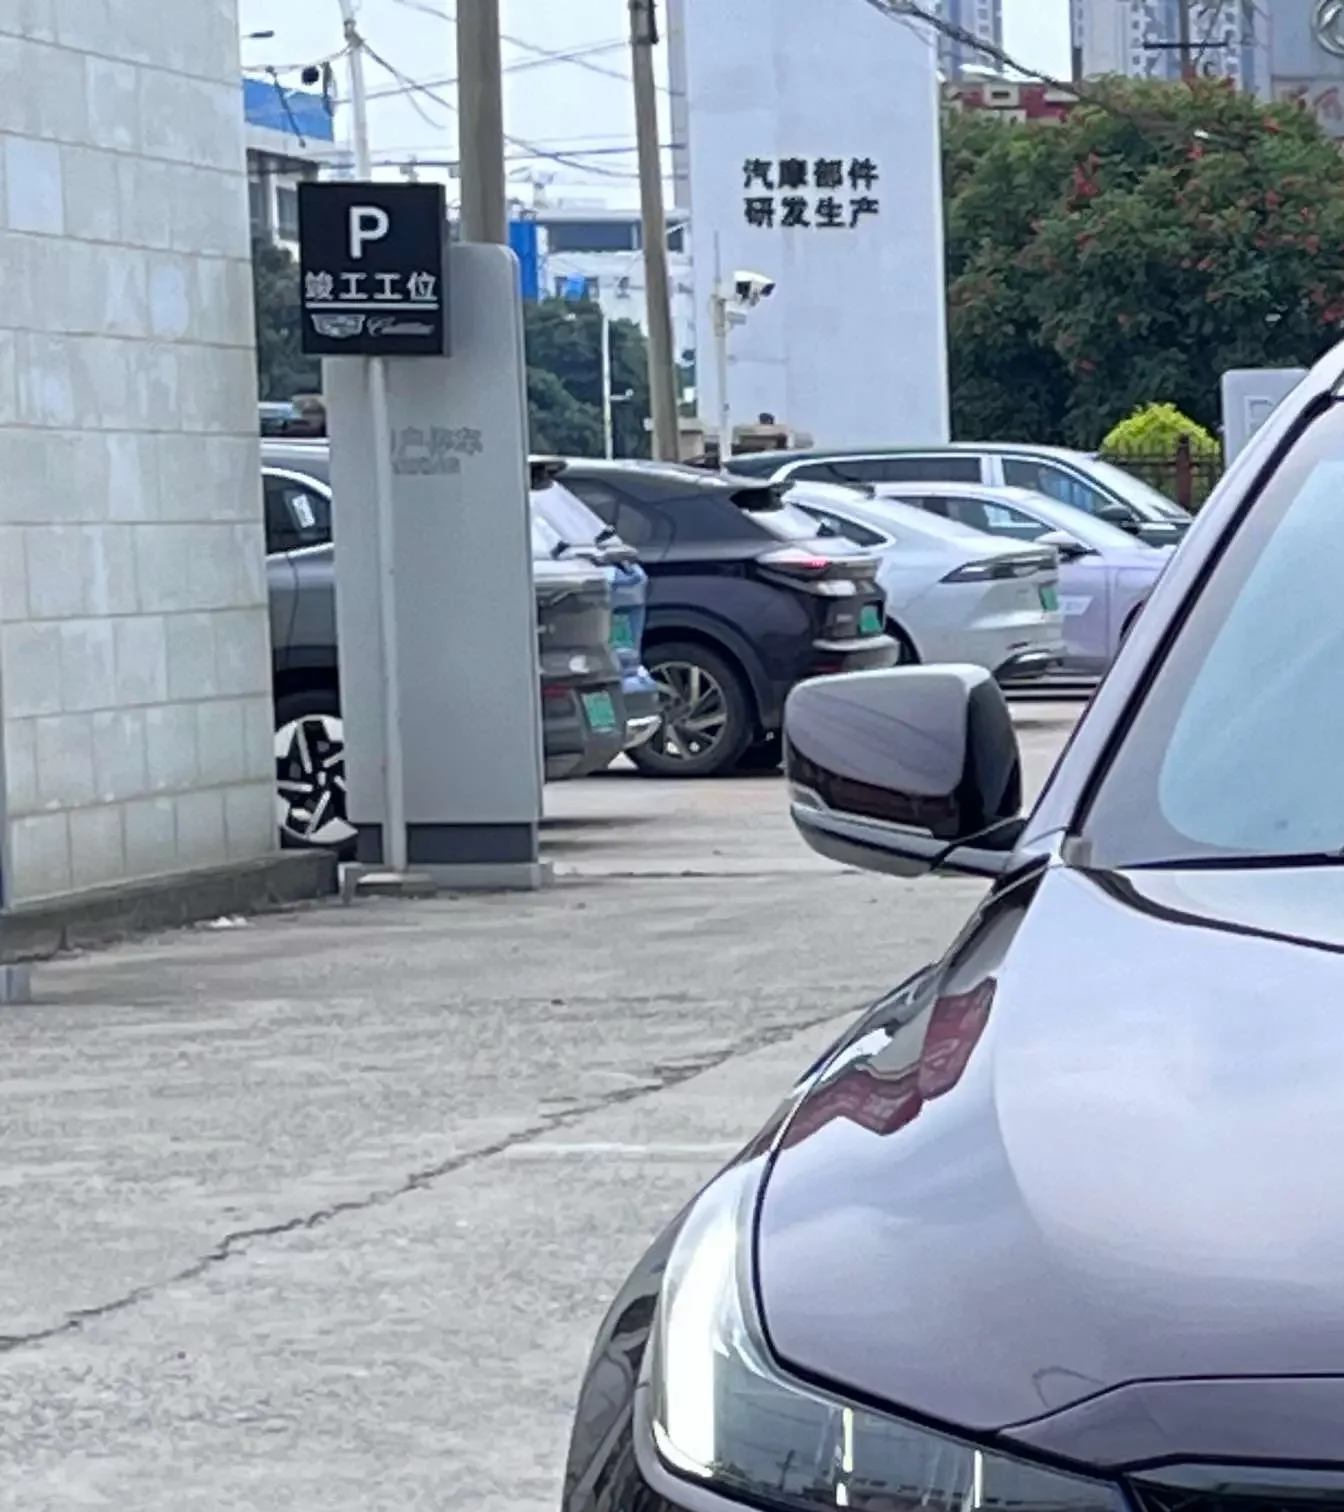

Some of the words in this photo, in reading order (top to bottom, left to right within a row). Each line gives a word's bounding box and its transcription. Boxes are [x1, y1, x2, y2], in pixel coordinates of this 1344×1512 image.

[350, 205, 390, 259] P
[743, 196, 880, 229] 研发生产
